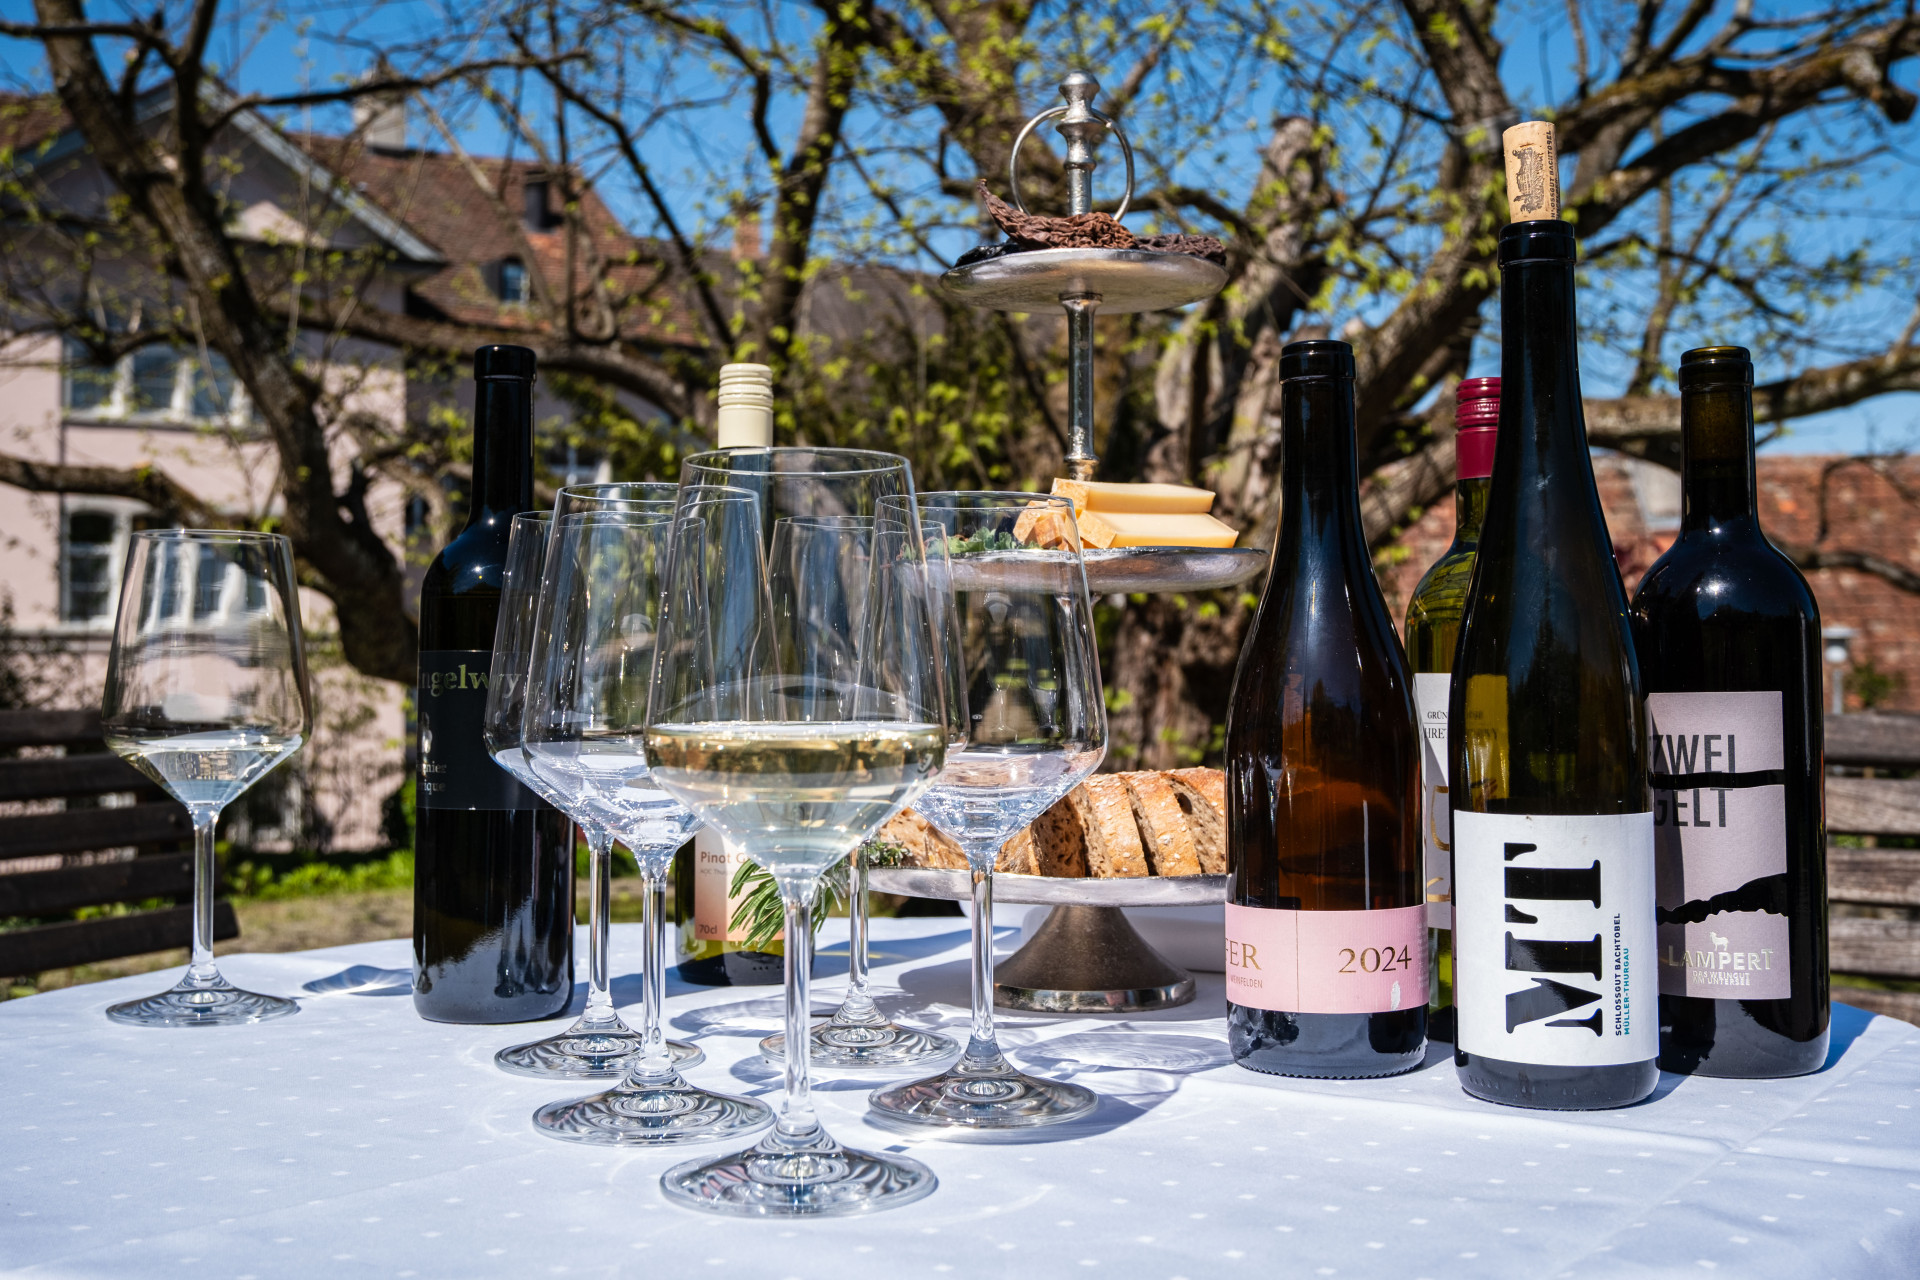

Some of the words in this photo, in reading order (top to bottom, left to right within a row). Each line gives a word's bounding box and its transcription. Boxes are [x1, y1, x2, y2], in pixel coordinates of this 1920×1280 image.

[419, 664, 522, 697] ngelwy
[1649, 735, 1736, 774] ZWEI
[1654, 788, 1734, 828] GELT
[700, 851, 731, 864] Pinot
[699, 924, 718, 934] 70cl
[1503, 842, 1603, 1037] MT
[1613, 913, 1621, 970] BACHTOBEL
[1338, 944, 1412, 974] 2024
[1667, 945, 1774, 970] LAMPERT
[1692, 970, 1708, 978] DAS
[1710, 971, 1750, 980] WEINGUT
[1614, 973, 1622, 1036] SCHLOSSGUT
[1622, 948, 1630, 1035] MÜLLER-THURGAU
